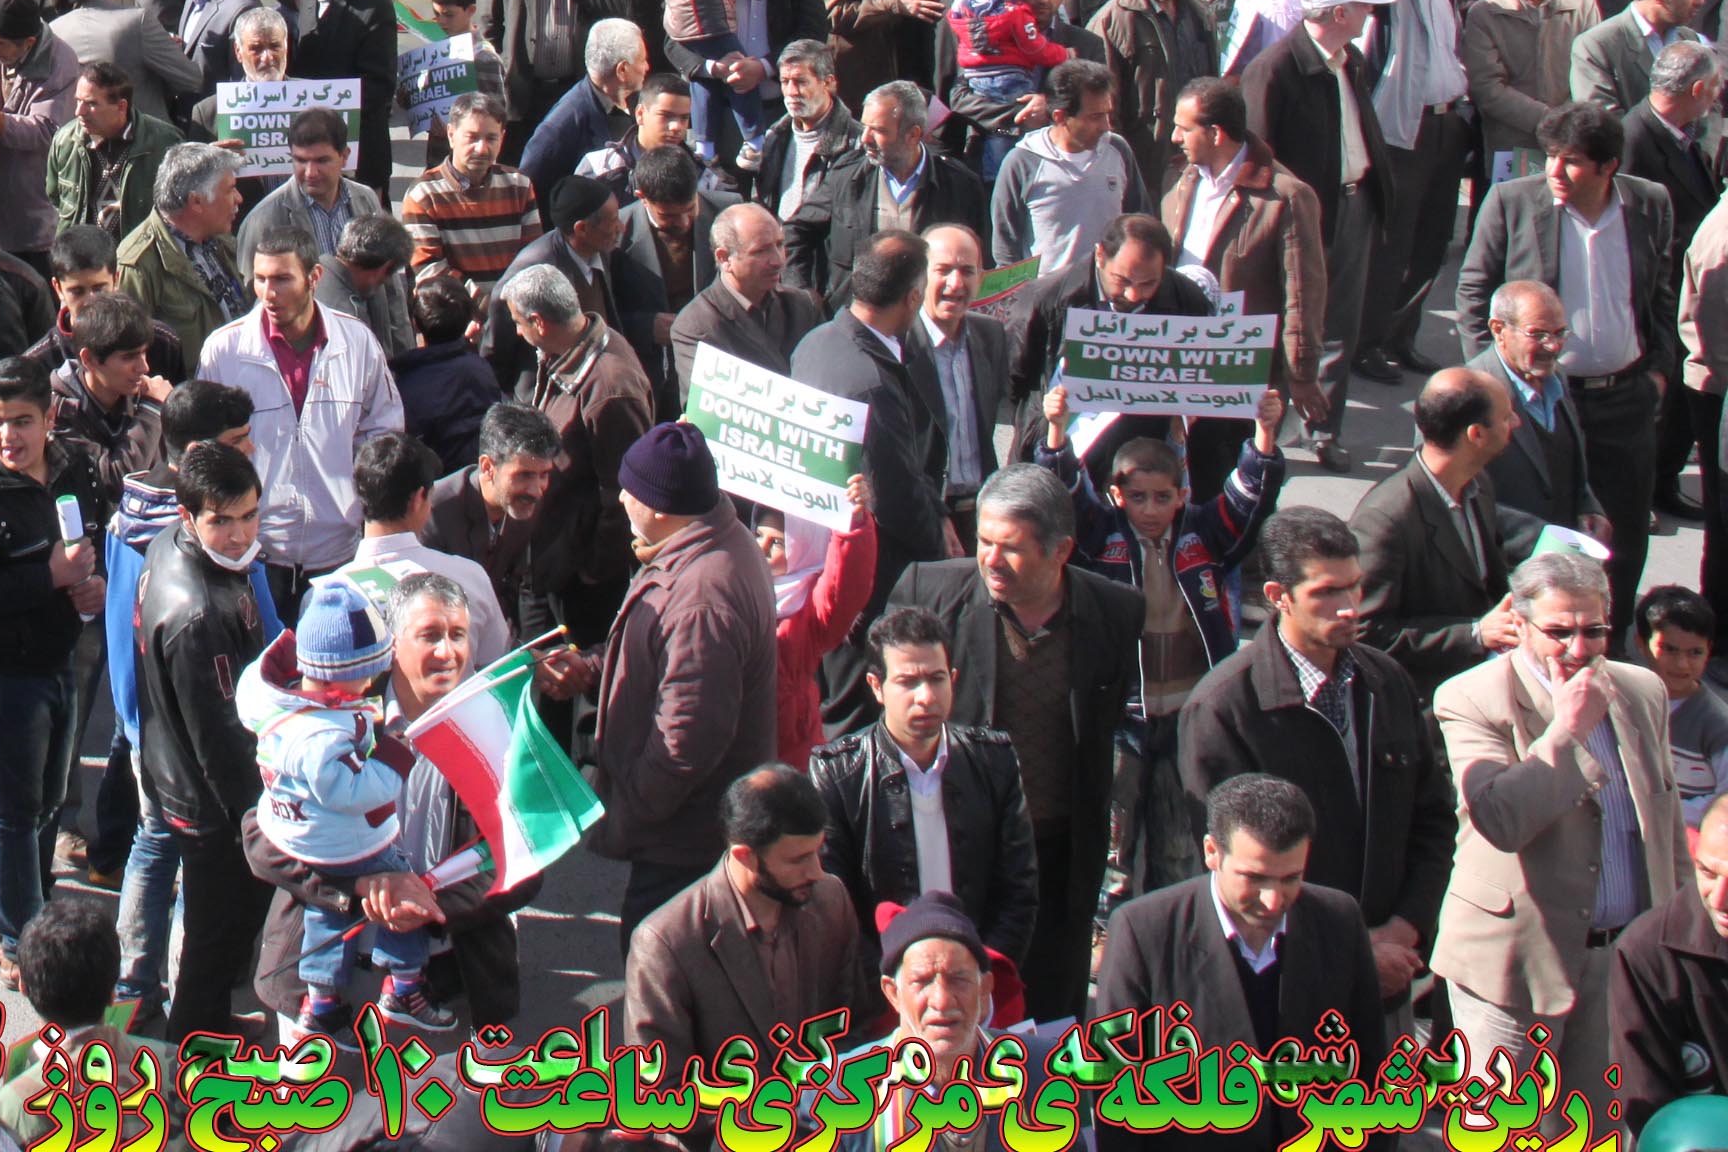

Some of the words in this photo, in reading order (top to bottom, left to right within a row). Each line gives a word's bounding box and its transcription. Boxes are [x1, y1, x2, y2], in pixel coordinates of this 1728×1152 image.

[432, 64, 467, 84] WITH
[225, 84, 287, 108] اسرائیل
[291, 89, 308, 108] بر
[313, 84, 353, 106] مرگ
[230, 113, 291, 131] DOWN
[1079, 314, 1169, 342] اسرائیل
[1174, 324, 1199, 344] بر
[1205, 319, 1264, 345] مرگ
[1082, 344, 1169, 366] DOWN
[1179, 348, 1256, 367] WITH
[1110, 365, 1215, 384] ISRAEL
[776, 393, 797, 415] بر
[1186, 390, 1253, 408] الموت
[698, 390, 773, 436] DOWN
[777, 420, 847, 463] WITH
[718, 423, 808, 474] ISRAEL
[780, 481, 841, 513] الموت
